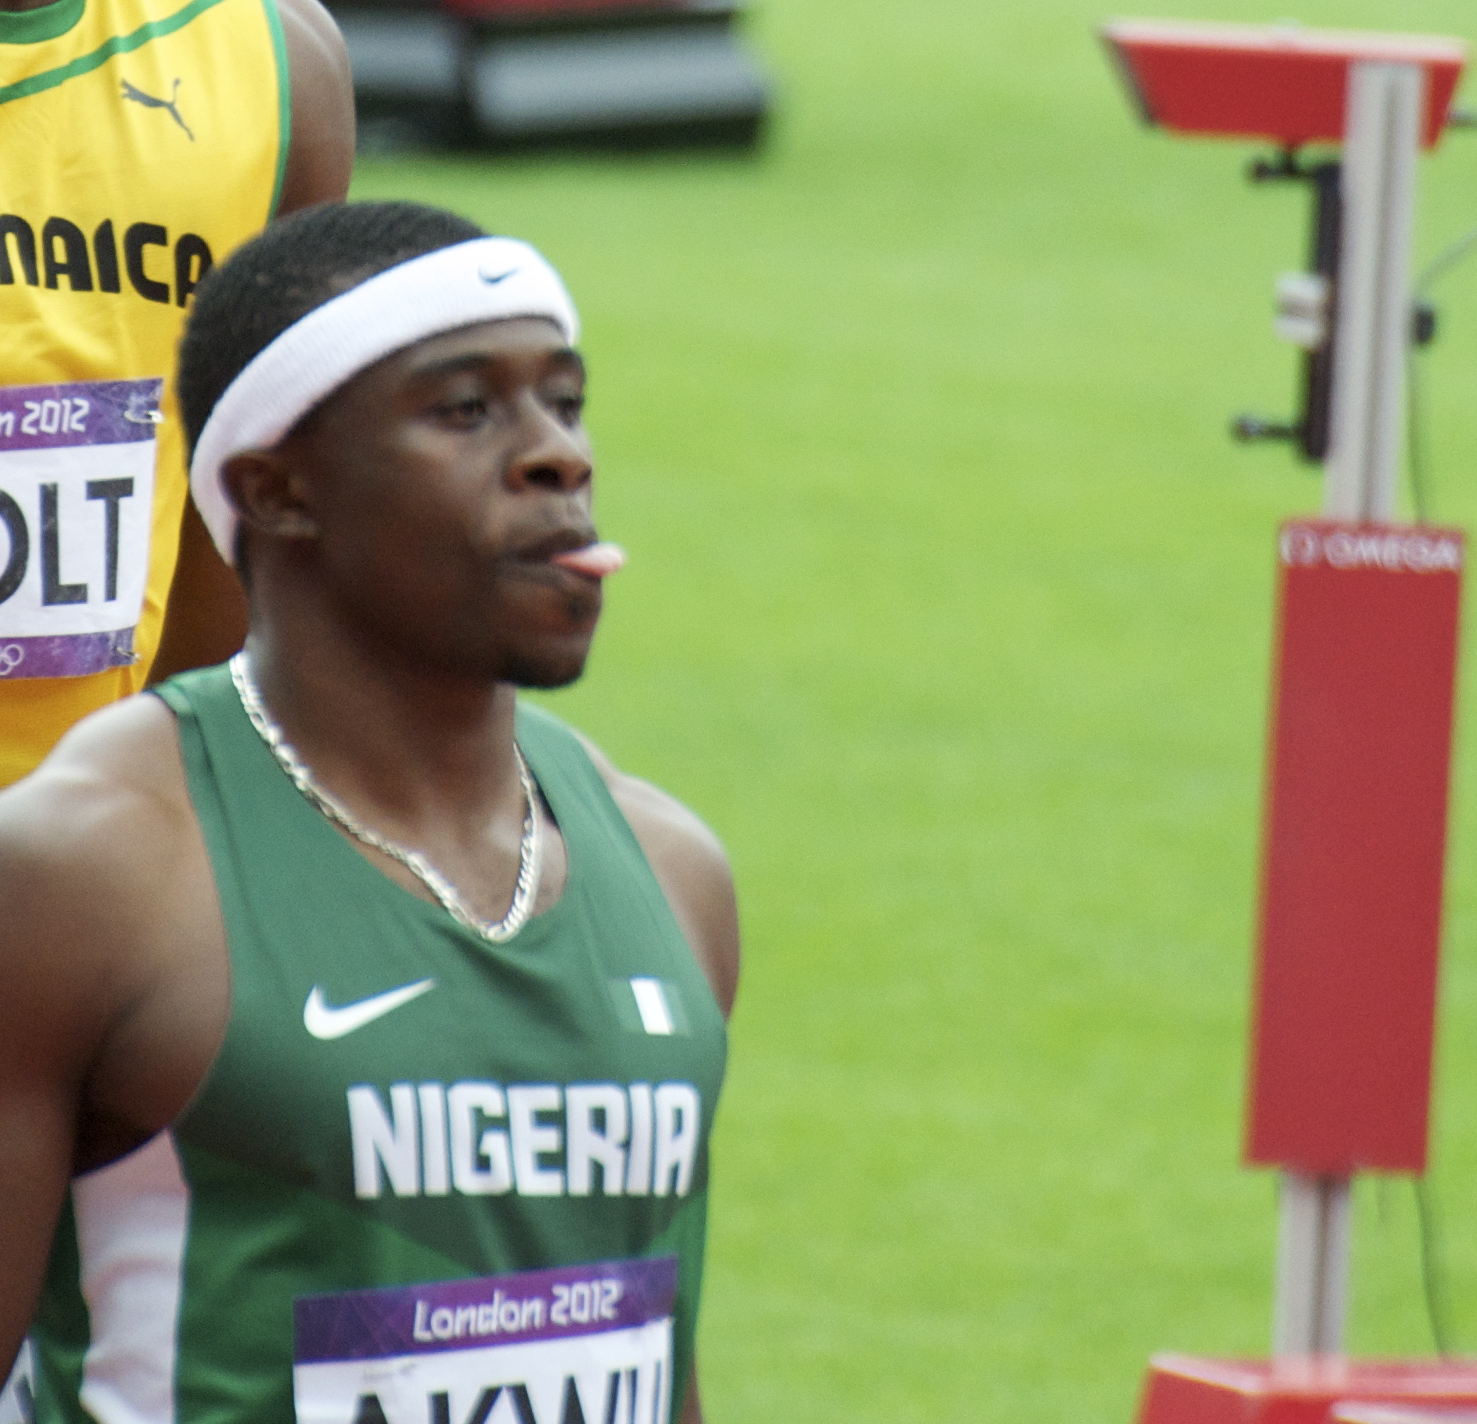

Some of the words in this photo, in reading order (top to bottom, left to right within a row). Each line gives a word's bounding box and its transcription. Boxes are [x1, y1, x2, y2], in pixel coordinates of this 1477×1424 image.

[21, 397, 90, 435] 2012
[1324, 531, 1462, 574] OMEGA
[347, 1080, 701, 1200] NIGERIA
[412, 1289, 544, 1343] London
[550, 1278, 624, 1321] 2012
